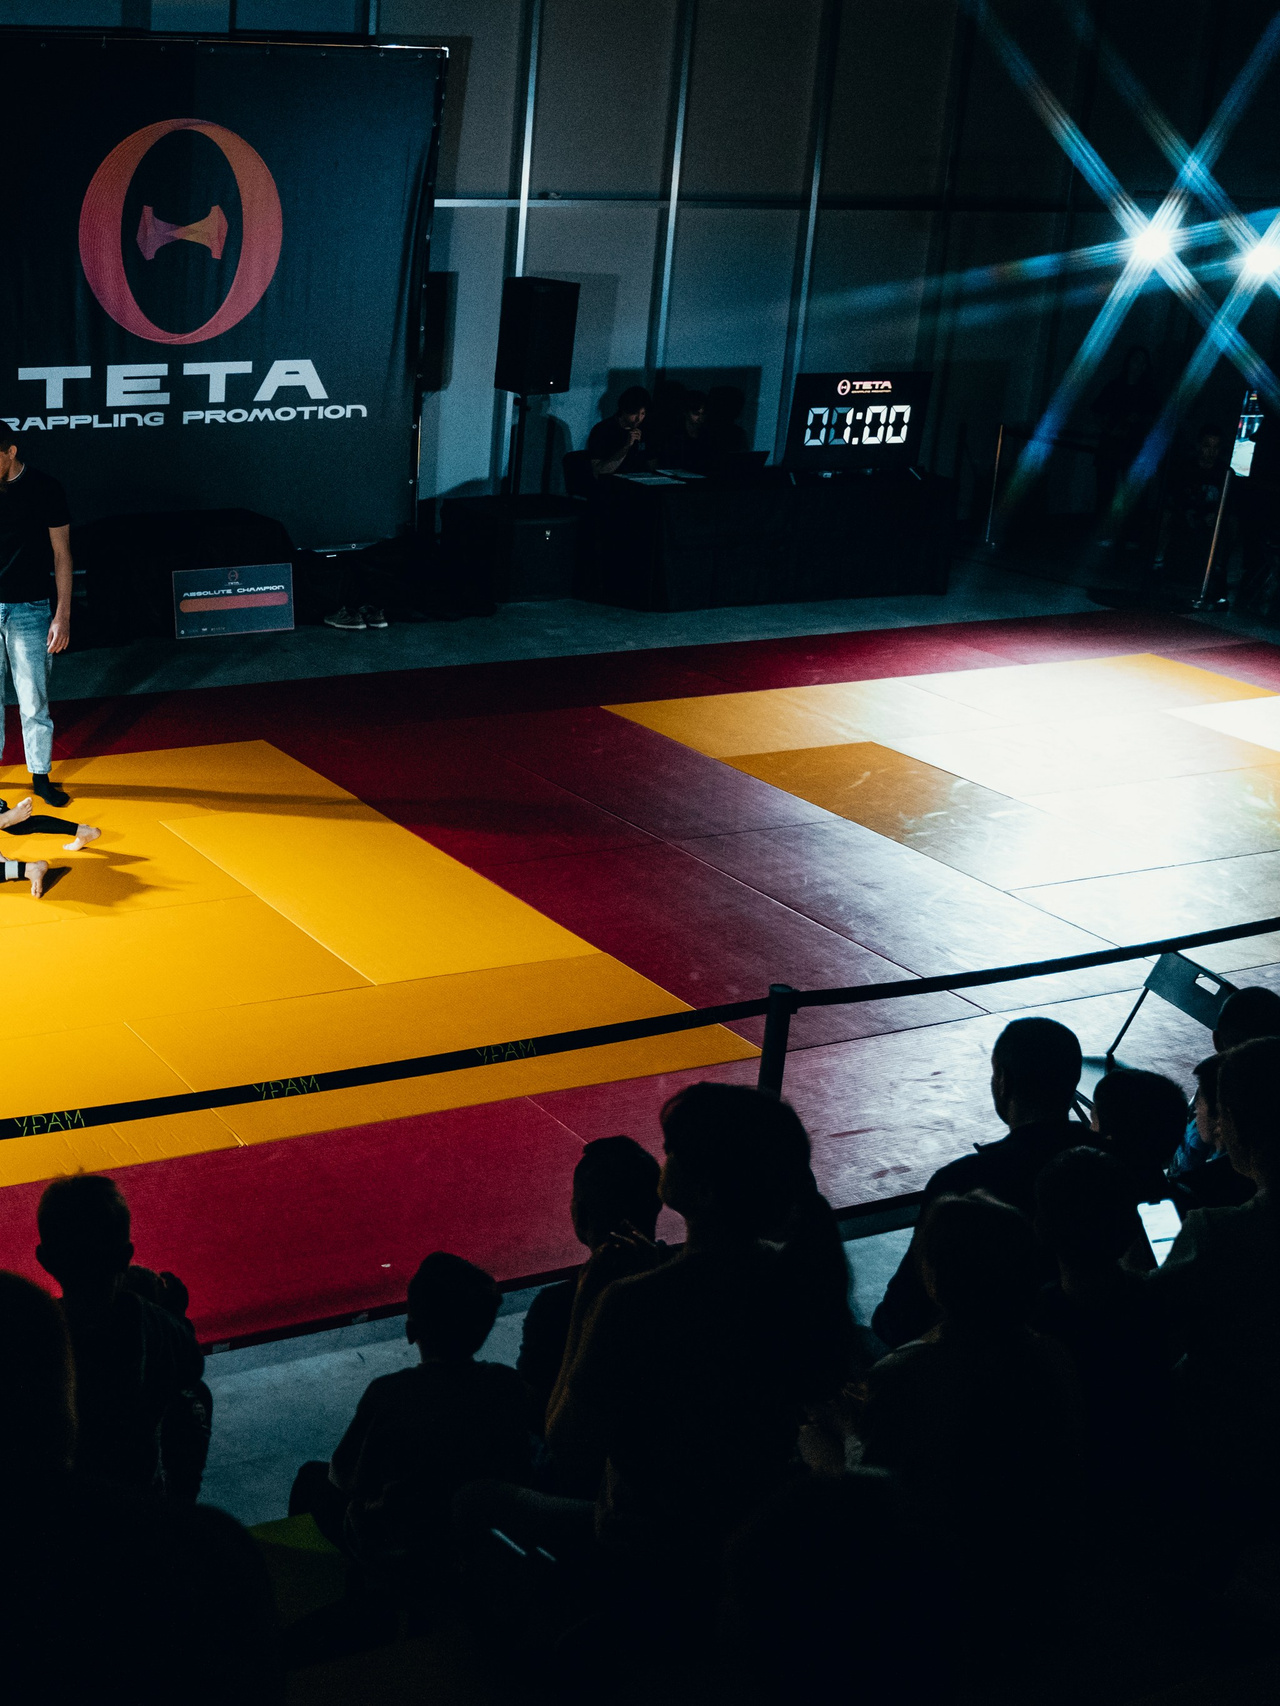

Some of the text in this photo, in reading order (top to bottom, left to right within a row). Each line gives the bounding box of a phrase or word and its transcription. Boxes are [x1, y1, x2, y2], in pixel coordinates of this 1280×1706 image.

[17, 359, 329, 410] TETA
[852, 380, 892, 390] TETA
[182, 404, 368, 425] PROMOTION
[183, 584, 284, 597] ABSOLUTE CHAMPION
